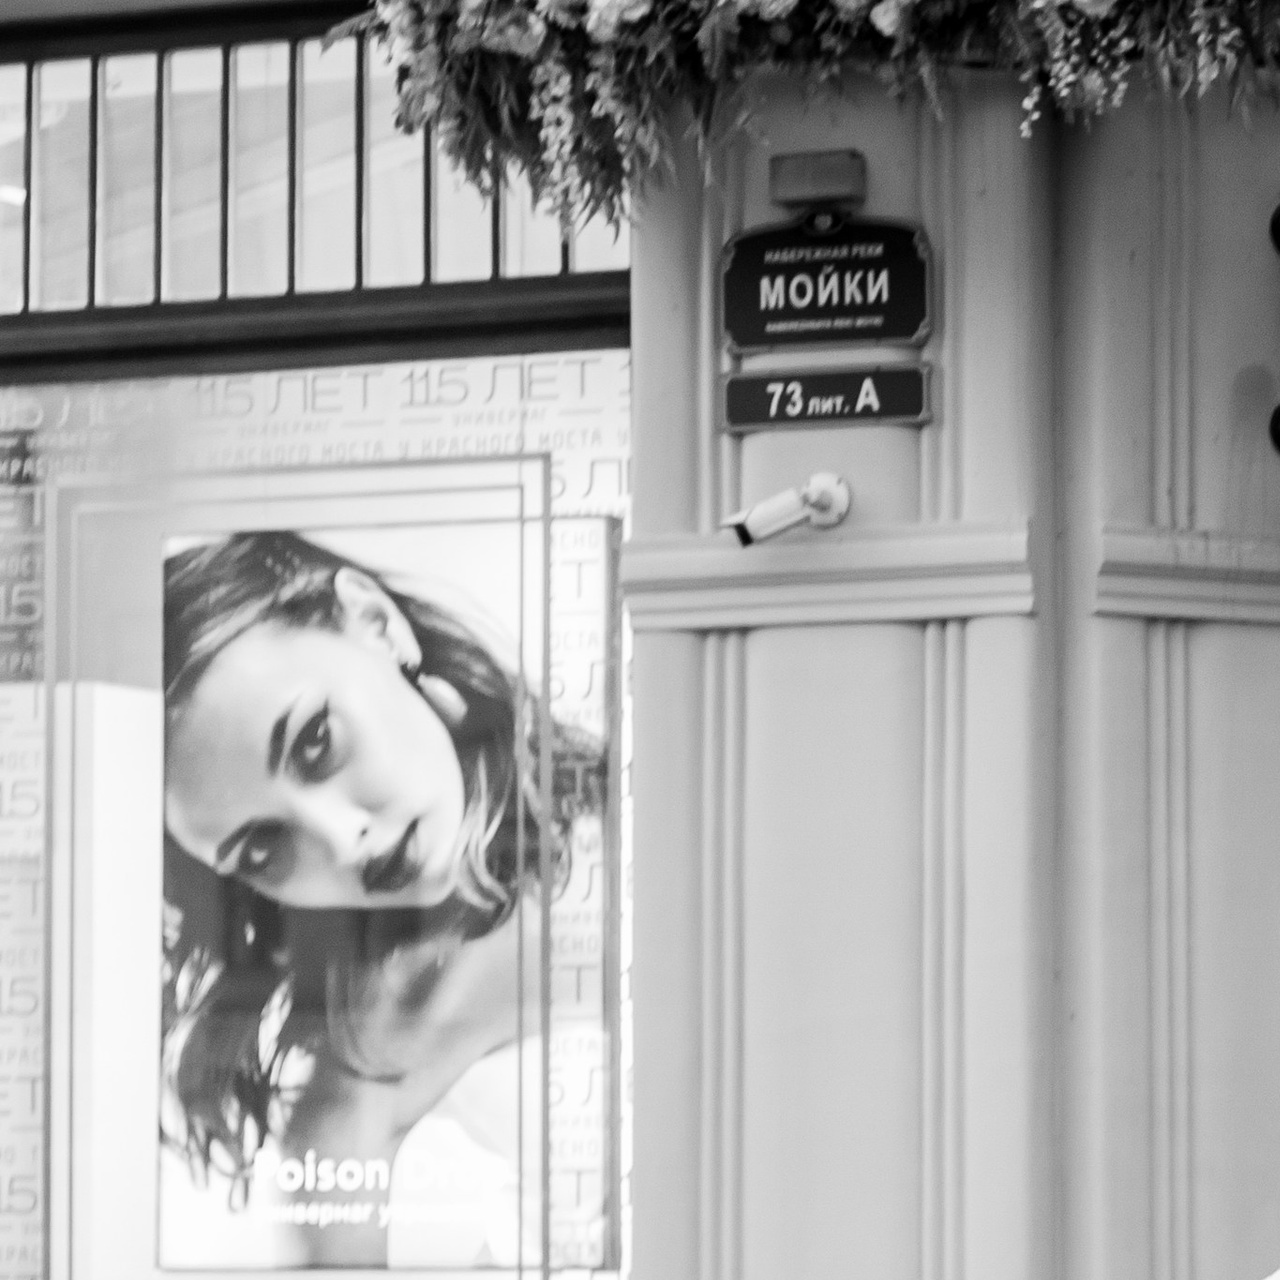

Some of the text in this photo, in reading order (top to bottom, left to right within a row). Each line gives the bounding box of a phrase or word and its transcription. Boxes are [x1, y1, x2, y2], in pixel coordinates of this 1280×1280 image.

[851, 242, 884, 259] РЕКИ
[759, 264, 889, 311] МОЙКИ
[268, 370, 385, 415] ЛЕТ
[400, 365, 470, 409] 115
[484, 357, 602, 405] ЛЕТ
[765, 380, 803, 418] 73
[854, 376, 881, 414] А
